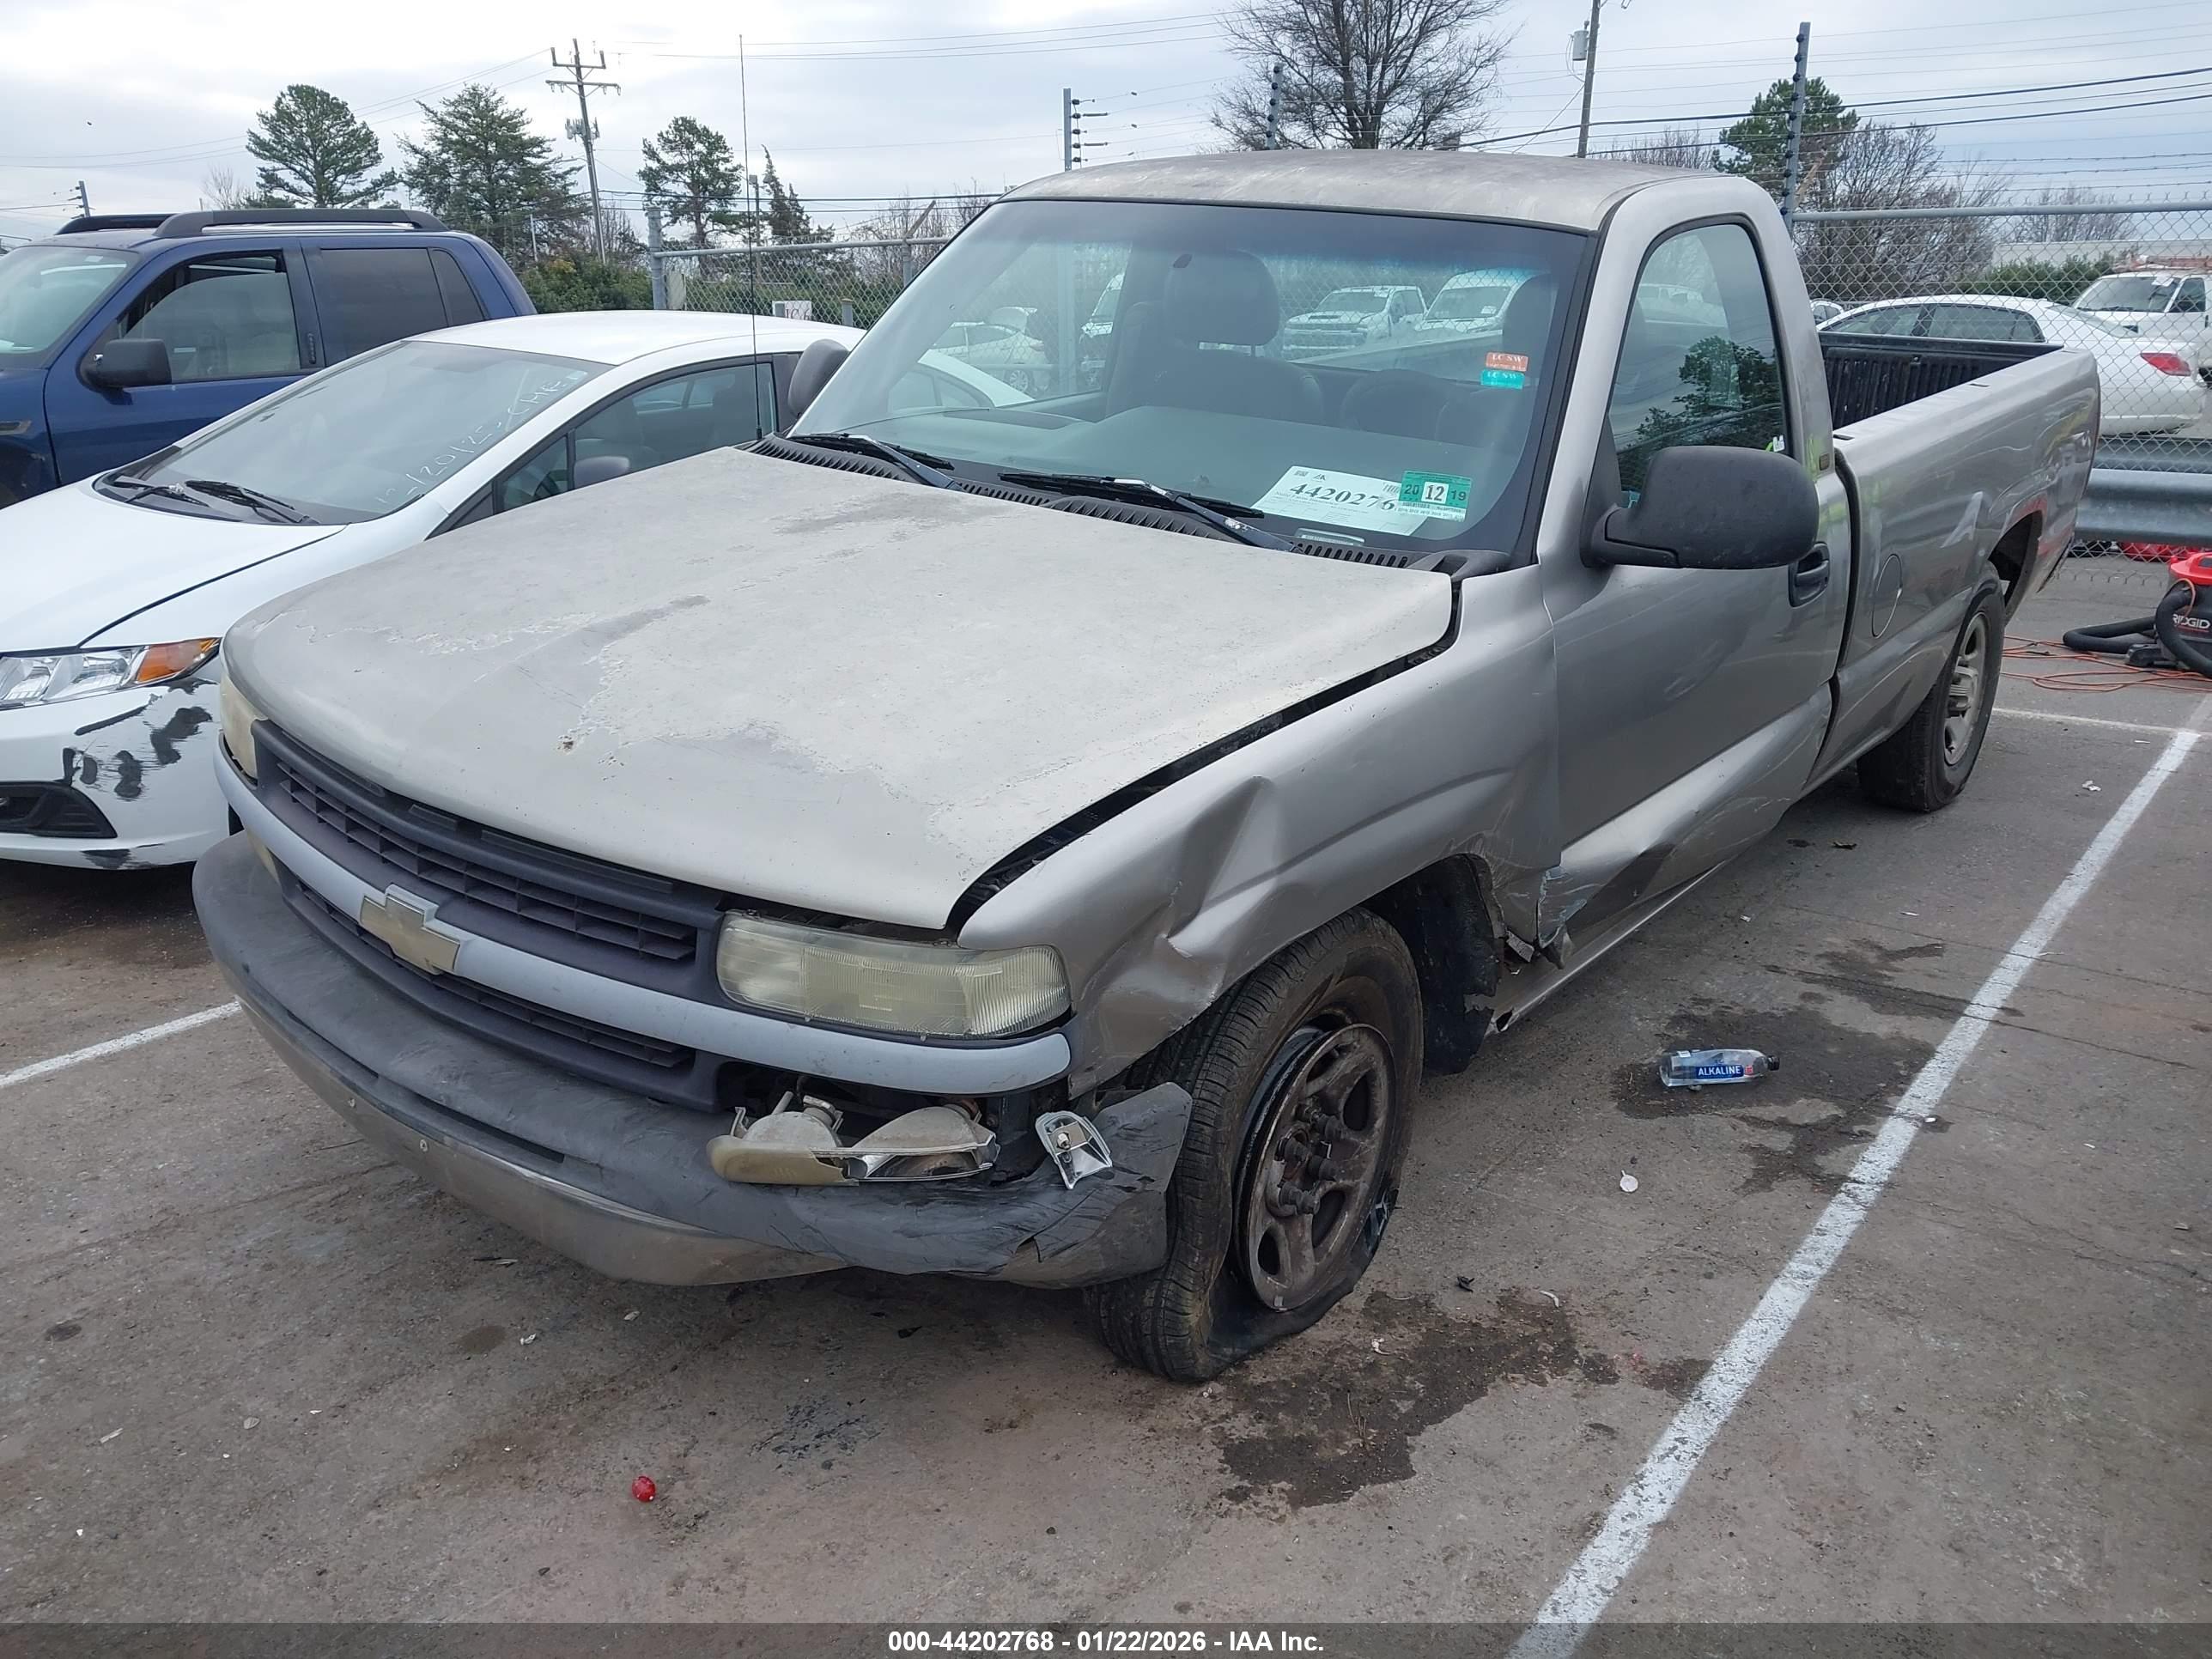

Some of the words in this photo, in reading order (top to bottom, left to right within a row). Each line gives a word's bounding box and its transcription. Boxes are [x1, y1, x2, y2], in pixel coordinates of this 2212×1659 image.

[1404, 484, 1419, 495] 20
[1424, 483, 1445, 502] 12
[1451, 489, 1467, 501] 19
[1698, 1065, 1741, 1077] ALKALINE
